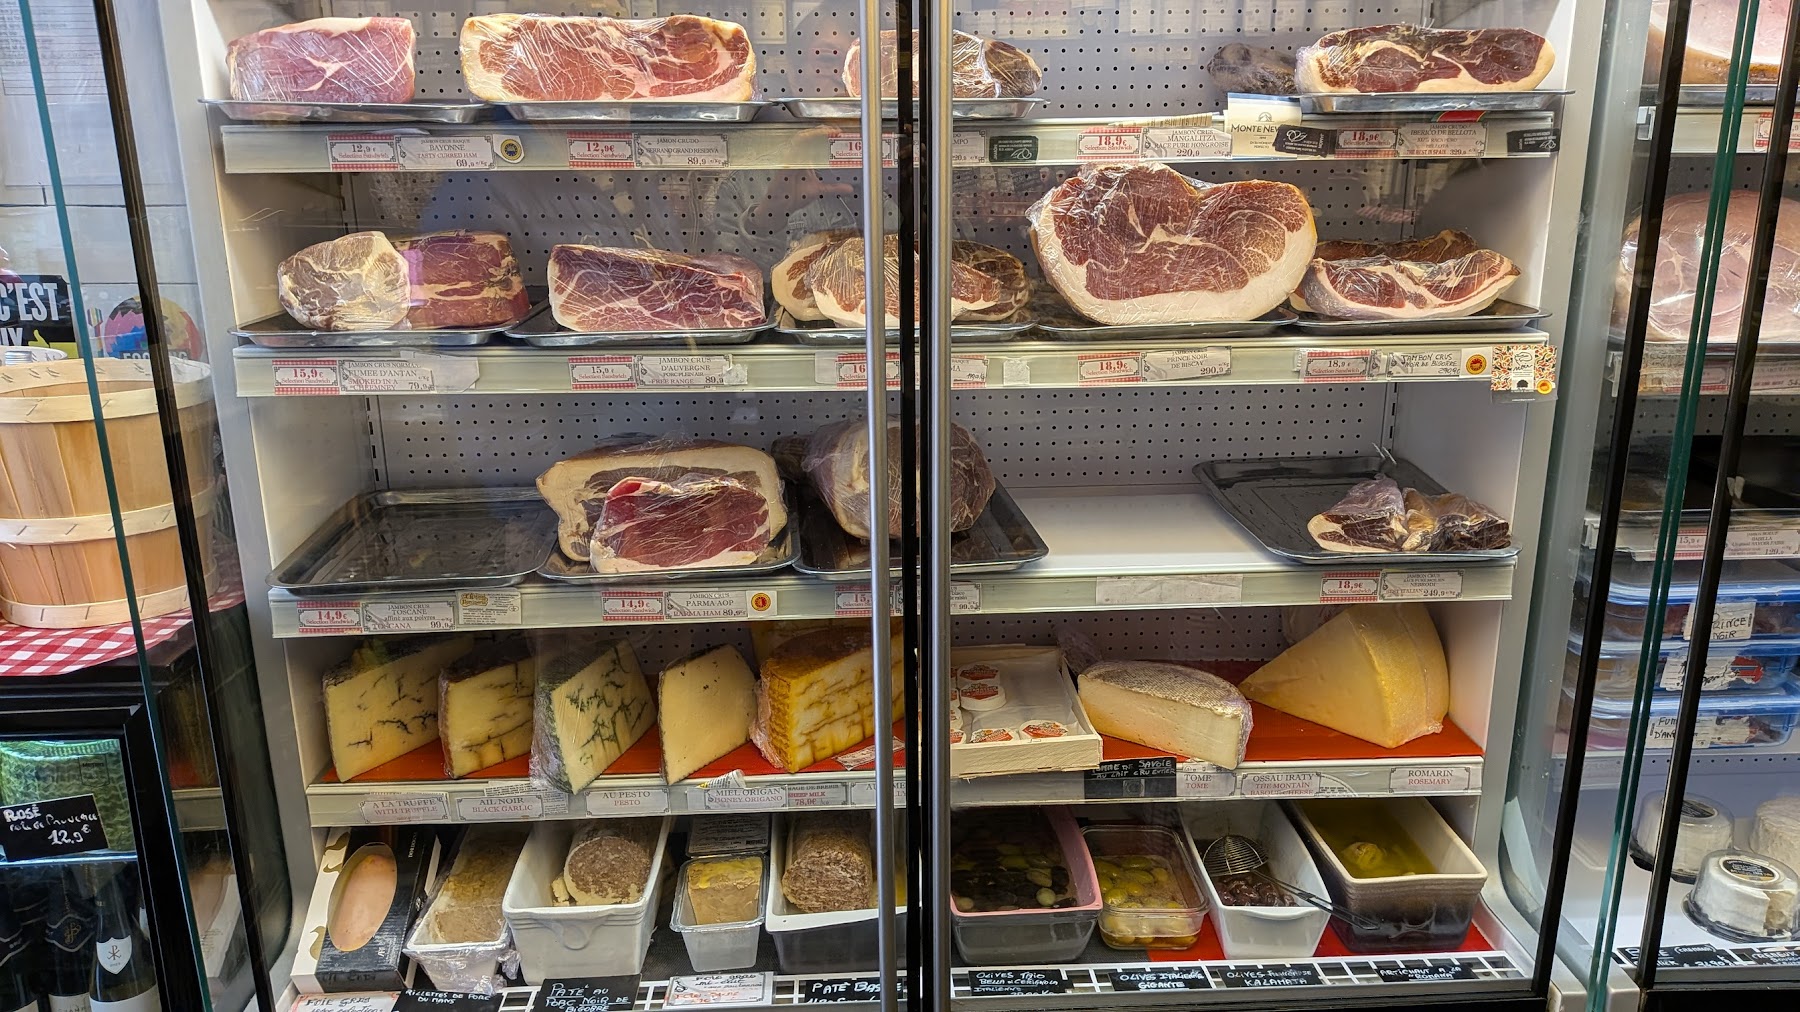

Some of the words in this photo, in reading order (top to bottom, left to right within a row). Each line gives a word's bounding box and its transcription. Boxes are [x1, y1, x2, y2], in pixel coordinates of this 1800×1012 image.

[1230, 124, 1262, 133] MONTE
[1098, 136, 1127, 147] 18,9€
[1168, 134, 1216, 142] MANGALITZA
[1166, 355, 1190, 363] PRINCE
[1400, 354, 1433, 364] JAMBON
[1434, 353, 1453, 361] CRUS
[1099, 360, 1128, 371] 18,9€
[317, 610, 347, 621] 14,9€
[1712, 612, 1747, 630] PRINCE
[372, 622, 412, 630] TOSCANA
[1712, 630, 1737, 640] NOIR
[1138, 760, 1172, 768] SAVOIE
[1111, 770, 1128, 778] LAIT
[1133, 768, 1150, 776] CRU
[1252, 774, 1284, 782] OSSAU
[1285, 773, 1314, 781] IRATY
[1408, 769, 1454, 778] ROMARIN
[1184, 774, 1212, 782] TOME
[1408, 778, 1452, 786] ROSEMARY
[602, 792, 617, 800] AU
[619, 790, 650, 798] PESTO
[716, 788, 738, 797] MIEL
[742, 788, 781, 796] ORIGAN
[396, 799, 437, 807] TRUFFE
[479, 798, 498, 806] AIL
[498, 796, 524, 805] NOIR
[3, 804, 41, 823] ROSÉ
[374, 808, 398, 816] WITH
[472, 806, 500, 814] BLACK
[502, 804, 533, 812] GARLIC
[1020, 972, 1046, 980] TRIO
[1380, 968, 1430, 976] ARTICHAUT
[1244, 978, 1308, 986] KALAMATA
[405, 989, 448, 998] RILLETTES
[306, 998, 334, 1006] FOIE
[338, 997, 370, 1006] GRAS
[546, 998, 577, 1009] PORC
